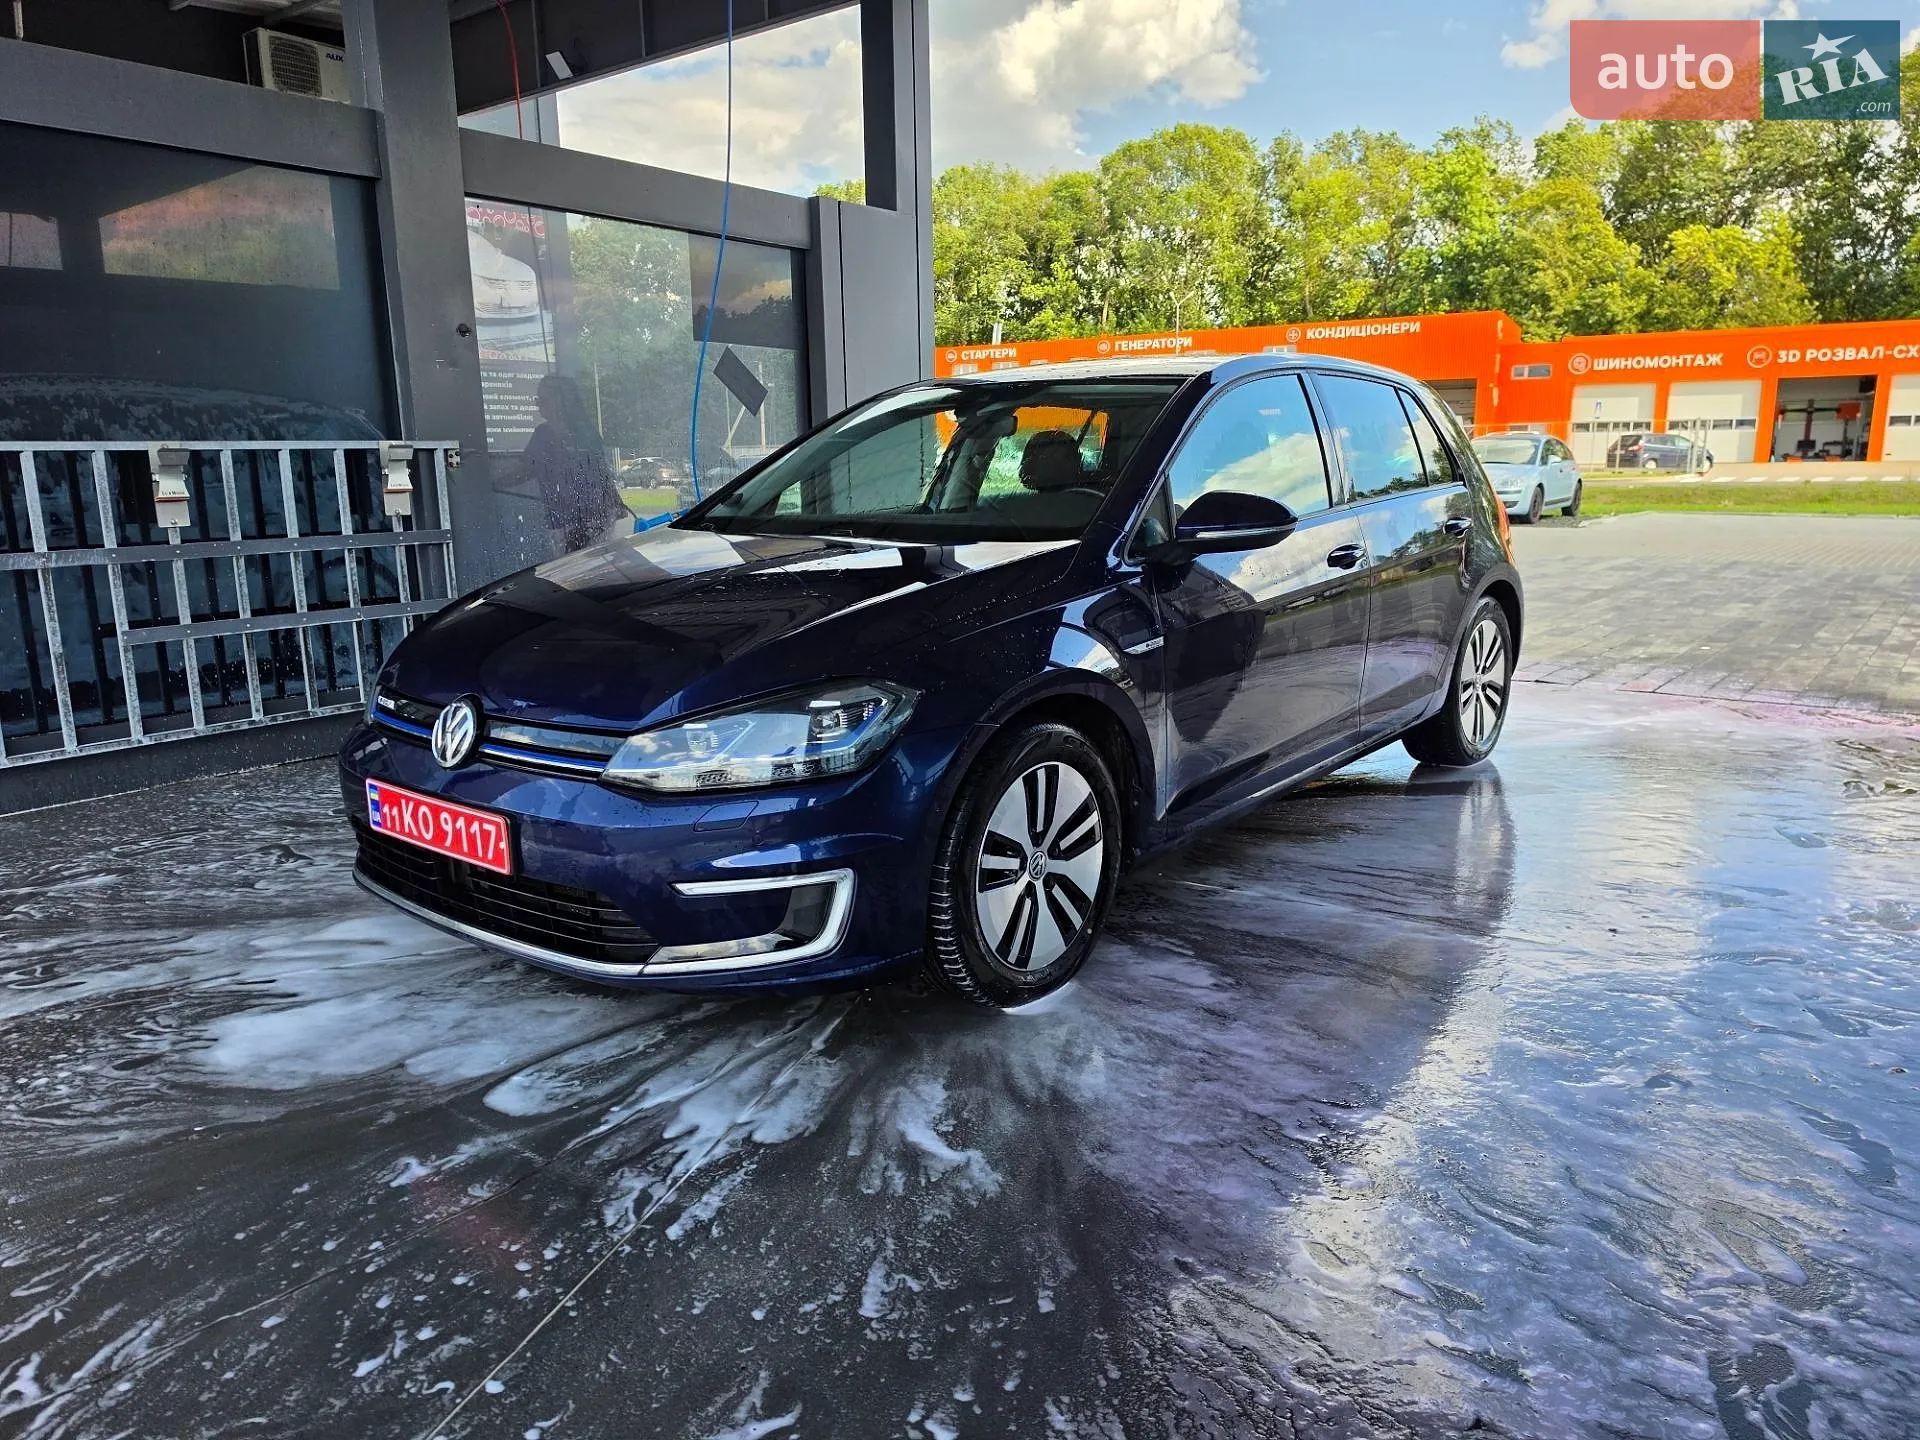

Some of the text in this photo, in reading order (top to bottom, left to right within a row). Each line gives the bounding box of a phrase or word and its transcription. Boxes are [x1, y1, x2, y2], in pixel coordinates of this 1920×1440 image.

[1306, 321, 1421, 340] КОНДИЦІОНЕРИ
[1114, 336, 1193, 351] ГЕНЕРАТОРИ
[961, 347, 1017, 361] СТАРТЕРИ
[1592, 353, 1723, 371] ШИНОМОНТАЖ
[1777, 350, 1801, 363] 3D
[440, 812, 496, 859] 9117
